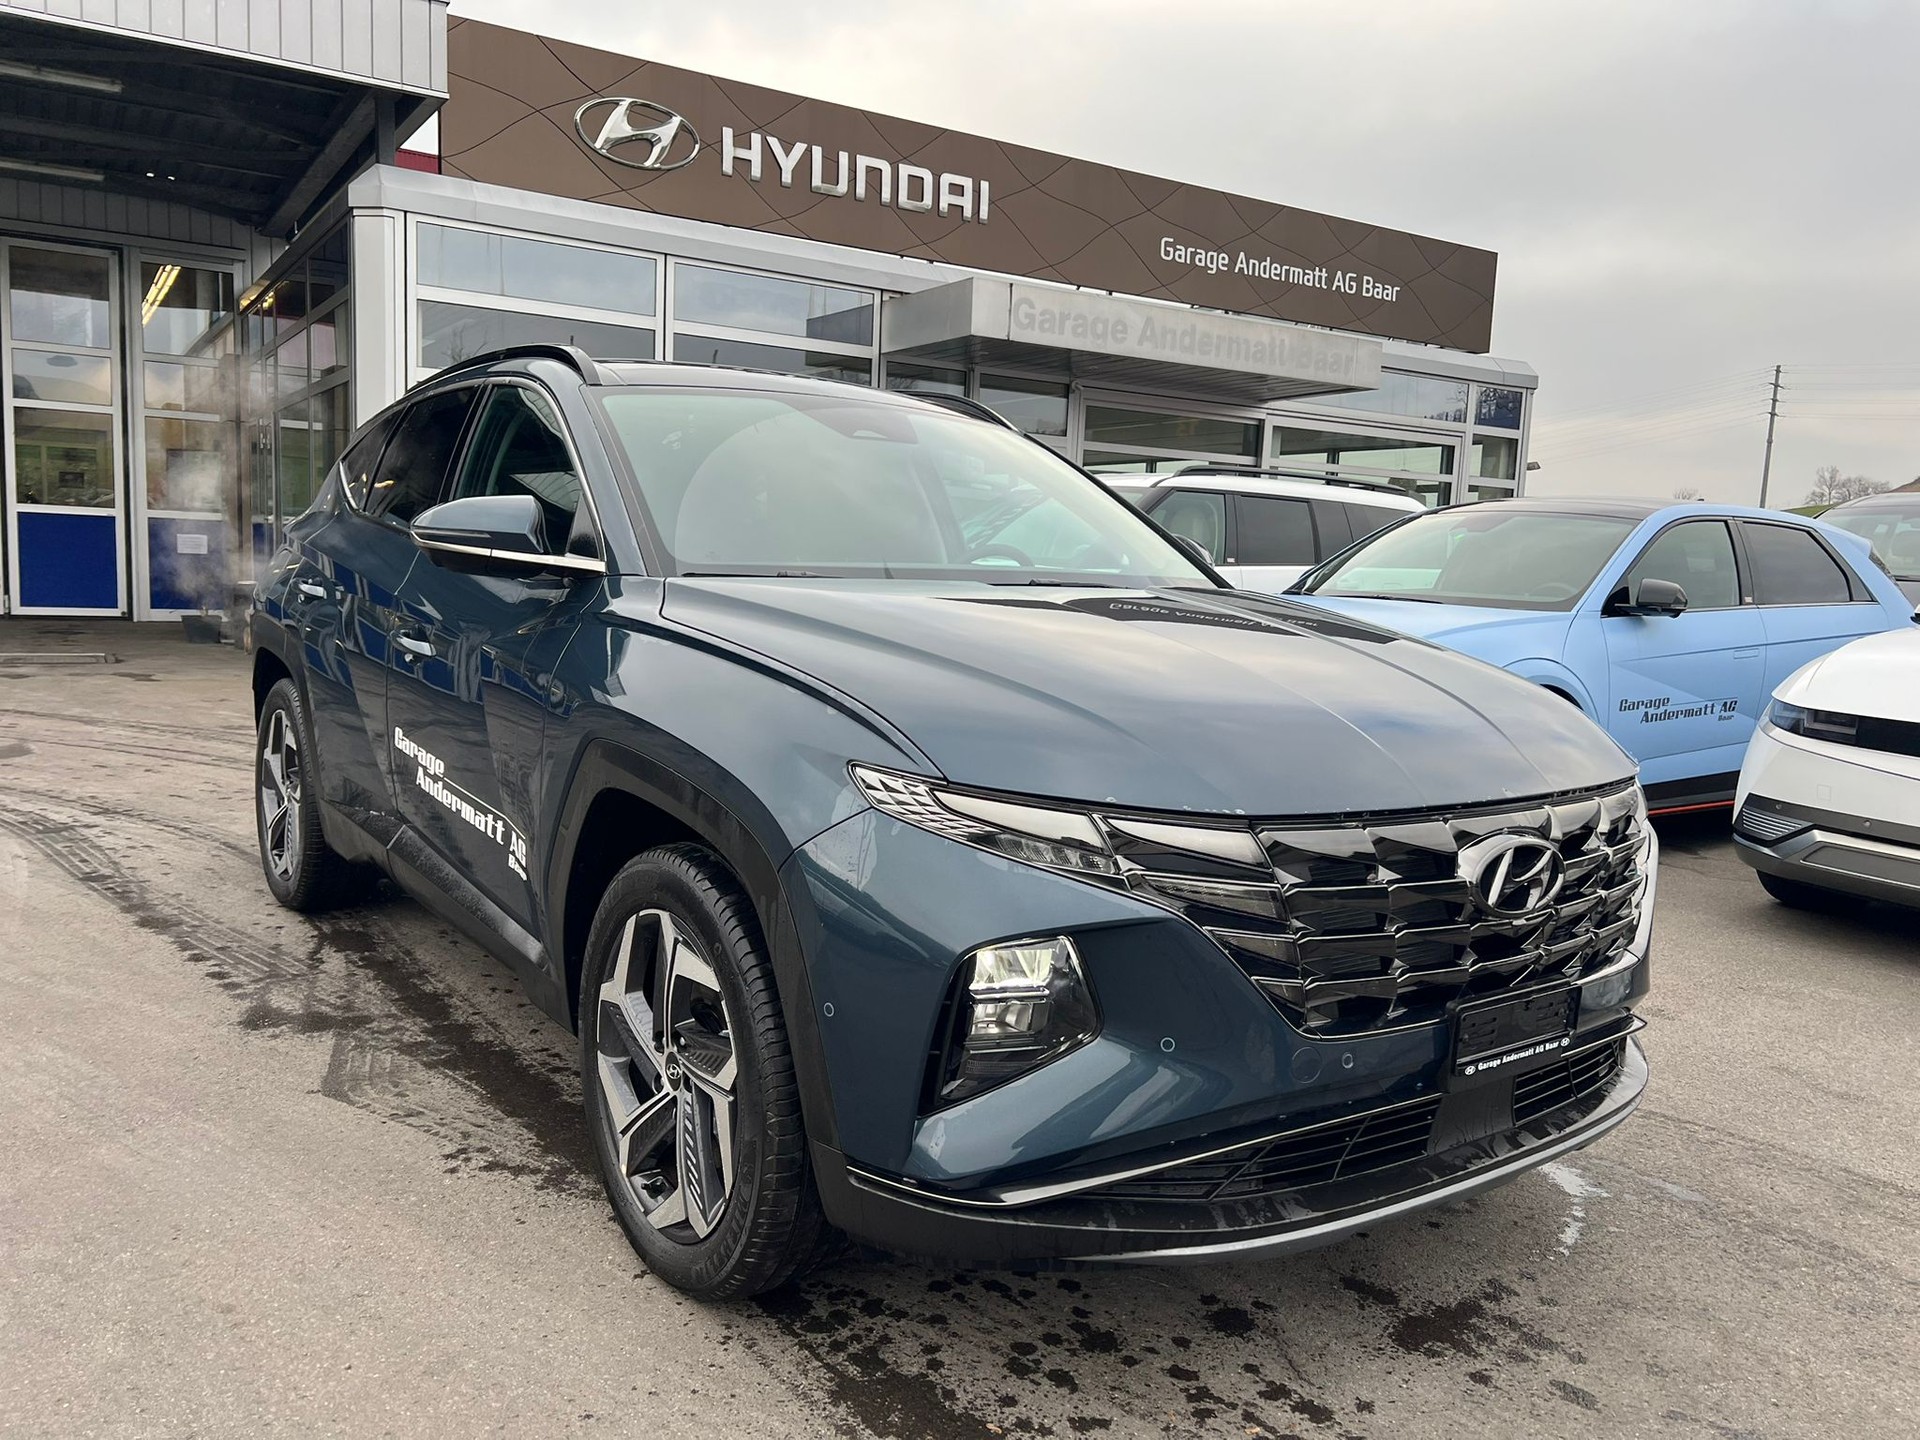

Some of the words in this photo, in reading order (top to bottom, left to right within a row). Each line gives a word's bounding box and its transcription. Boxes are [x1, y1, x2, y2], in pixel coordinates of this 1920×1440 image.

[721, 126, 990, 225] HYUNDAI
[1160, 236, 1229, 275] Garage
[1234, 251, 1328, 290] Andermatt
[1332, 270, 1358, 294] AG
[1362, 275, 1401, 302] Baar
[1012, 297, 1129, 348] Garage
[1137, 315, 1288, 365] Andermatt
[1298, 342, 1355, 377] Baar
[1619, 697, 1670, 711] Garage
[1640, 703, 1715, 723] Andermatt
[1719, 701, 1737, 713] AG
[394, 726, 445, 778] Garage
[416, 765, 506, 846] Andermatt
[509, 830, 527, 868] AG
[1478, 1059, 1501, 1070] Garage
[1502, 1048, 1534, 1063] Andermatt
[1535, 1044, 1544, 1054] AG
[1545, 1041, 1559, 1051] Baar
